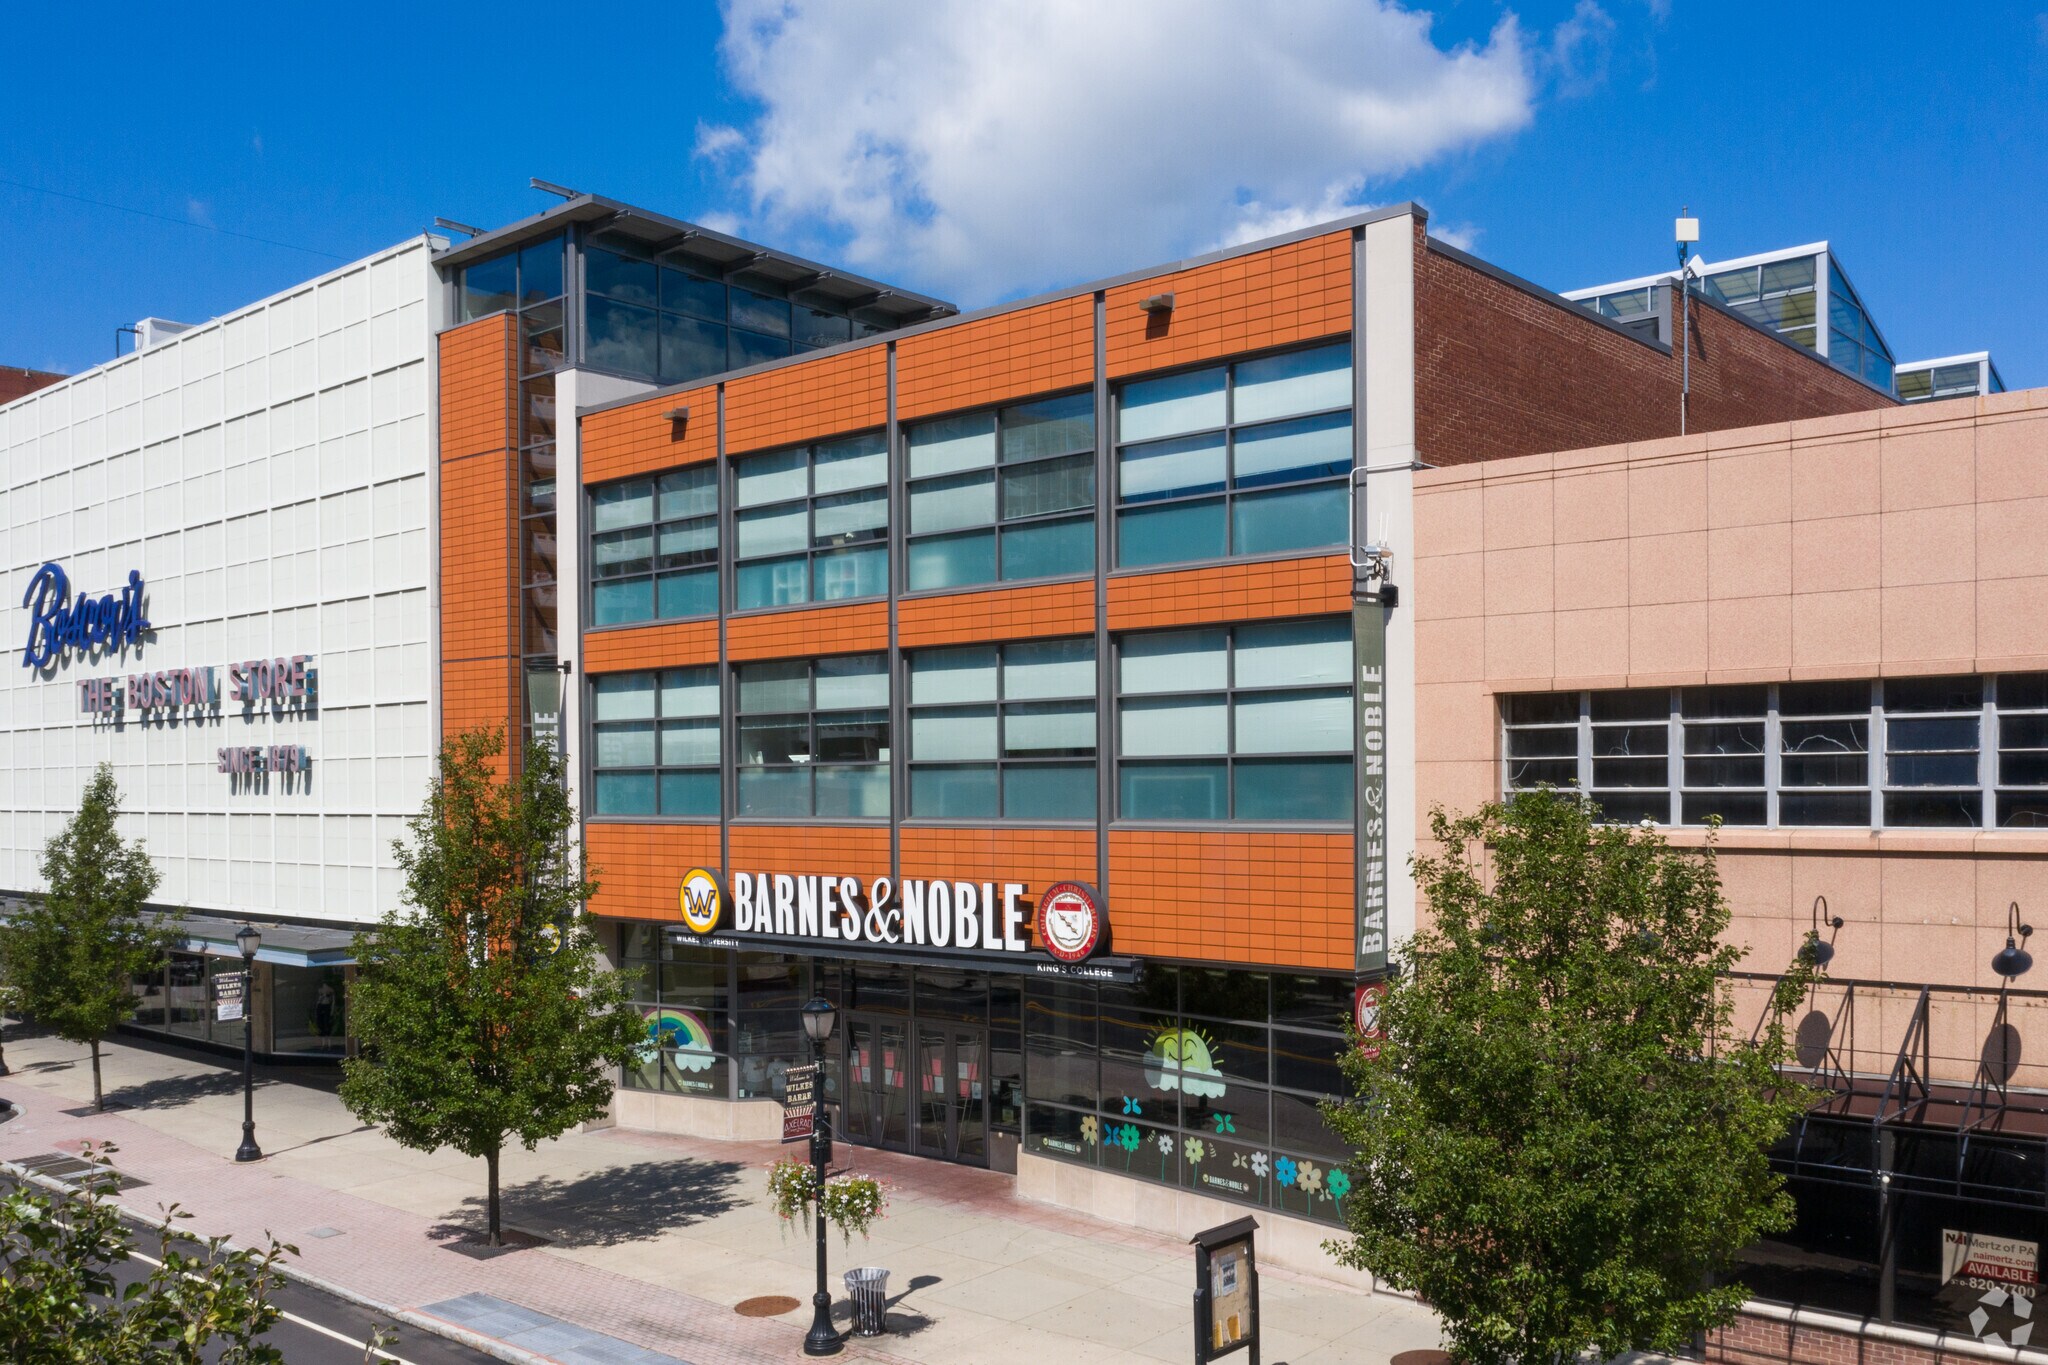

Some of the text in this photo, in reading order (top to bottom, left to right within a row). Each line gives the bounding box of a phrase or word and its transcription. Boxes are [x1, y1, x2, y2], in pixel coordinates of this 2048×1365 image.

[23, 562, 151, 668] Boscov's
[77, 655, 307, 713] THE BOSTON STORE
[217, 744, 300, 774] SINCE 1879
[676, 935, 700, 944] WILKES
[1037, 963, 1114, 978] KING'S COLLEGE
[786, 1081, 813, 1093] WILKES
[787, 1091, 812, 1103] BARRE
[1945, 1232, 2036, 1256] NAI Mertz of PA
[1973, 1252, 2035, 1267] naimertz.com
[1967, 1262, 2035, 1283] AVAILABLE
